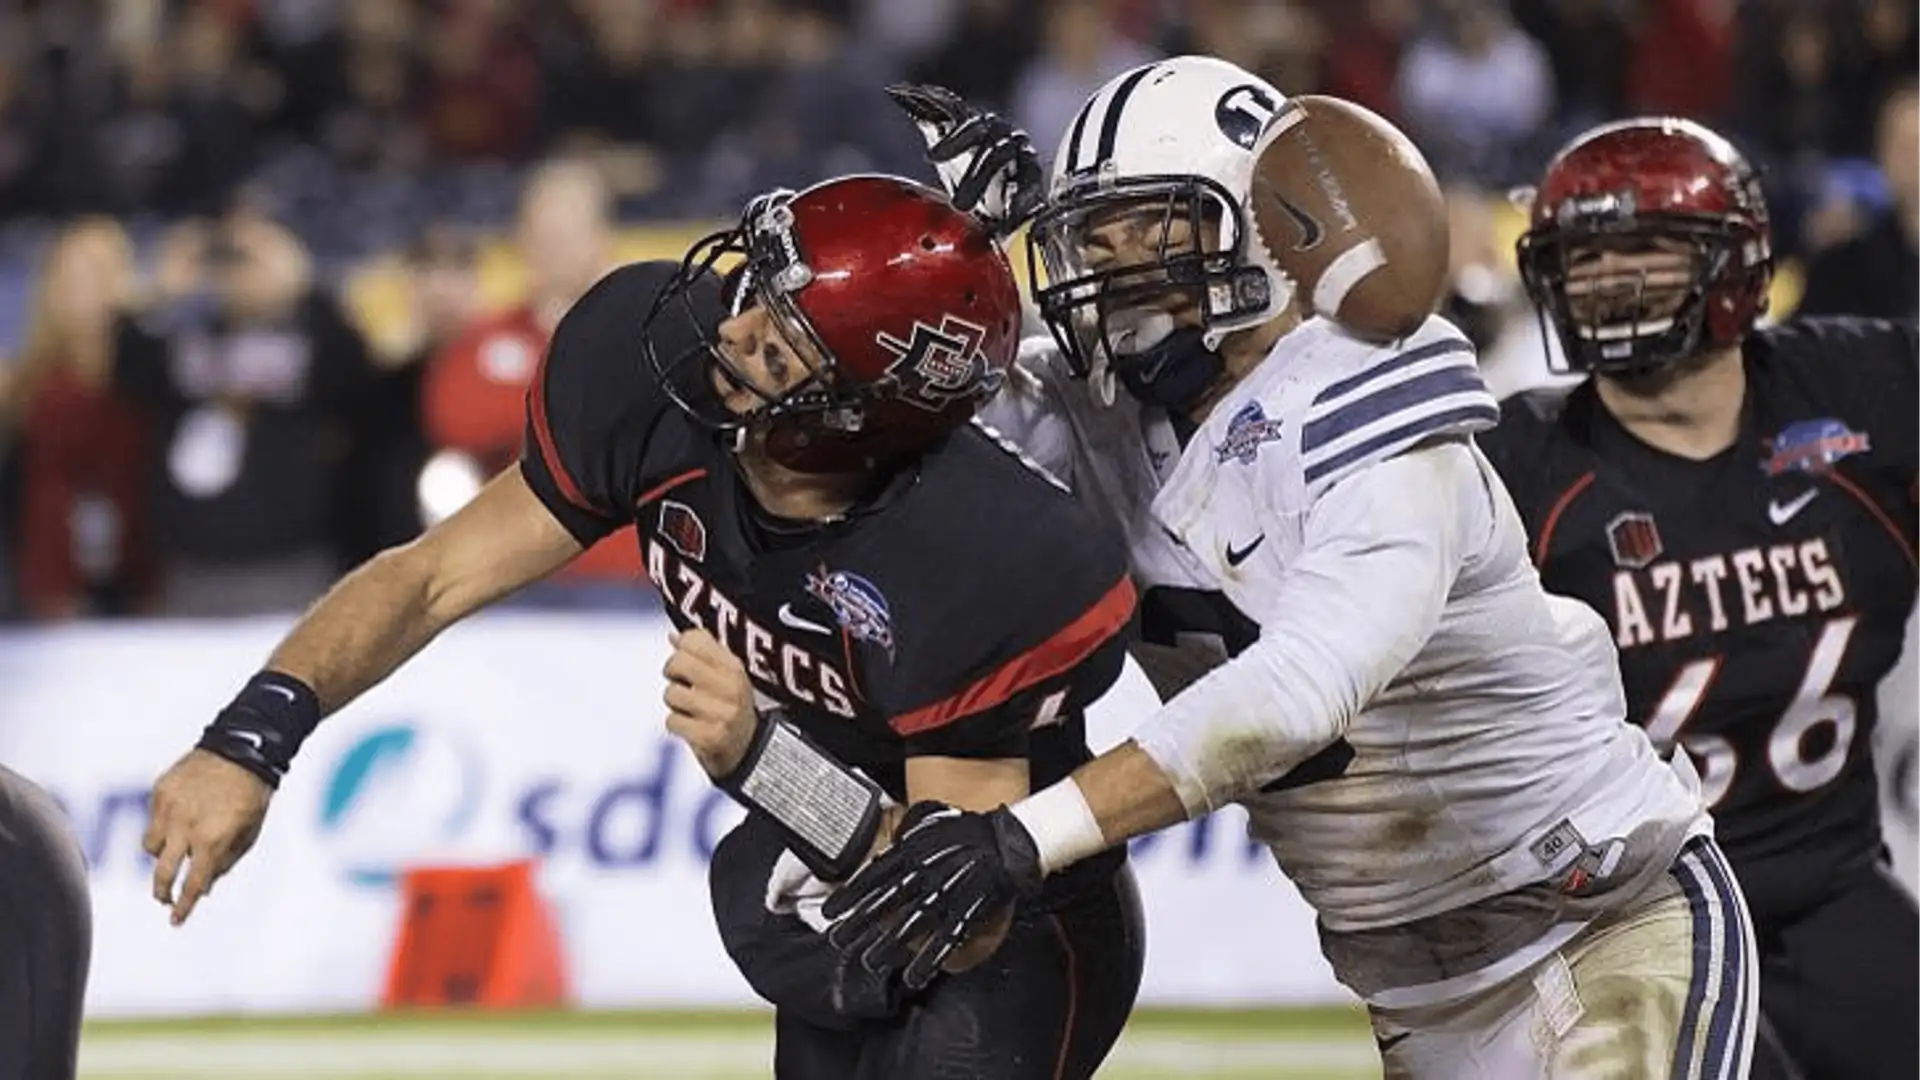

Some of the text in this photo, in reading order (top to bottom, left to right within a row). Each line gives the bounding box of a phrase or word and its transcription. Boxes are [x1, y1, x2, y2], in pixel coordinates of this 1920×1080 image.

[649, 539, 857, 718] AZTECS
[1613, 536, 1844, 648] AZTECS
[1543, 836, 1564, 856] 40
